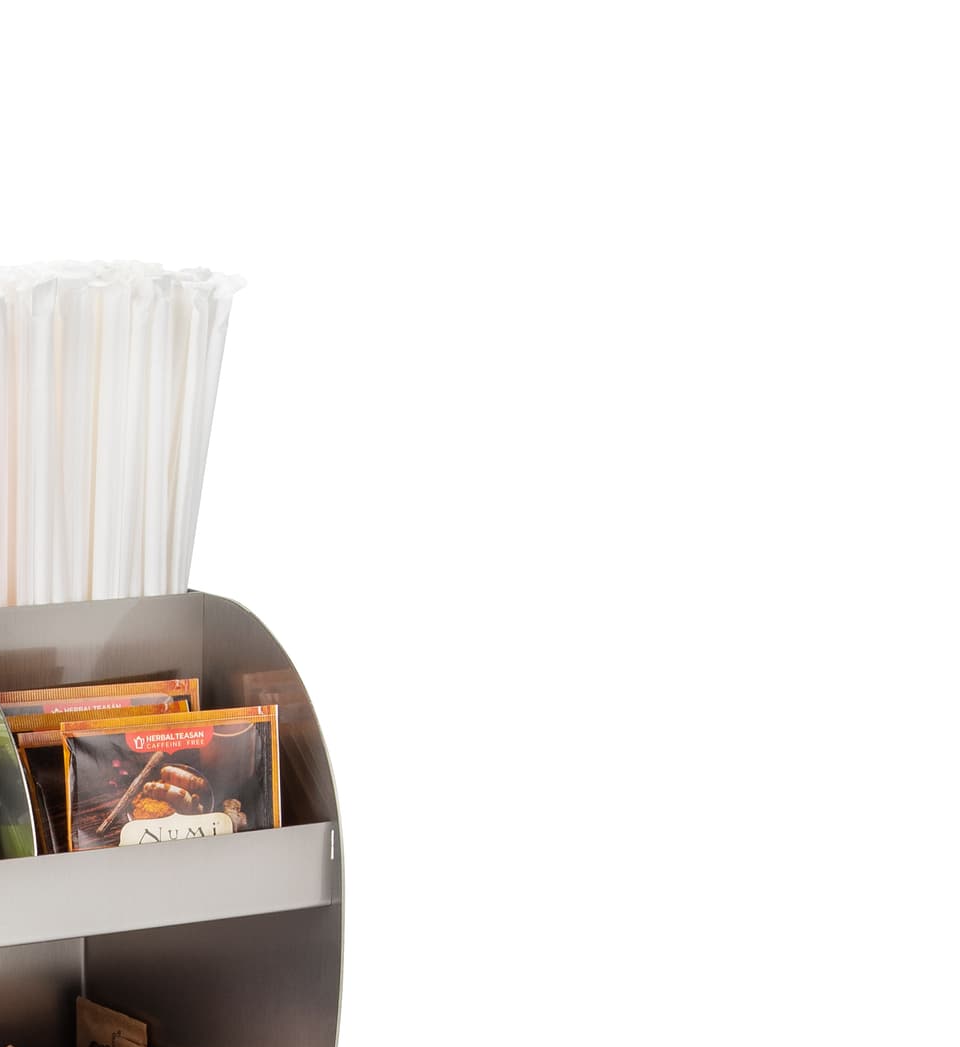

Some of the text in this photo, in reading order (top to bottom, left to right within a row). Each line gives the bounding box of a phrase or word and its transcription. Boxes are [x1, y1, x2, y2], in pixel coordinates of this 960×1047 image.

[146, 731, 205, 743] HERBAL TEASAN
[147, 738, 205, 749] CAFFEINE FREE
